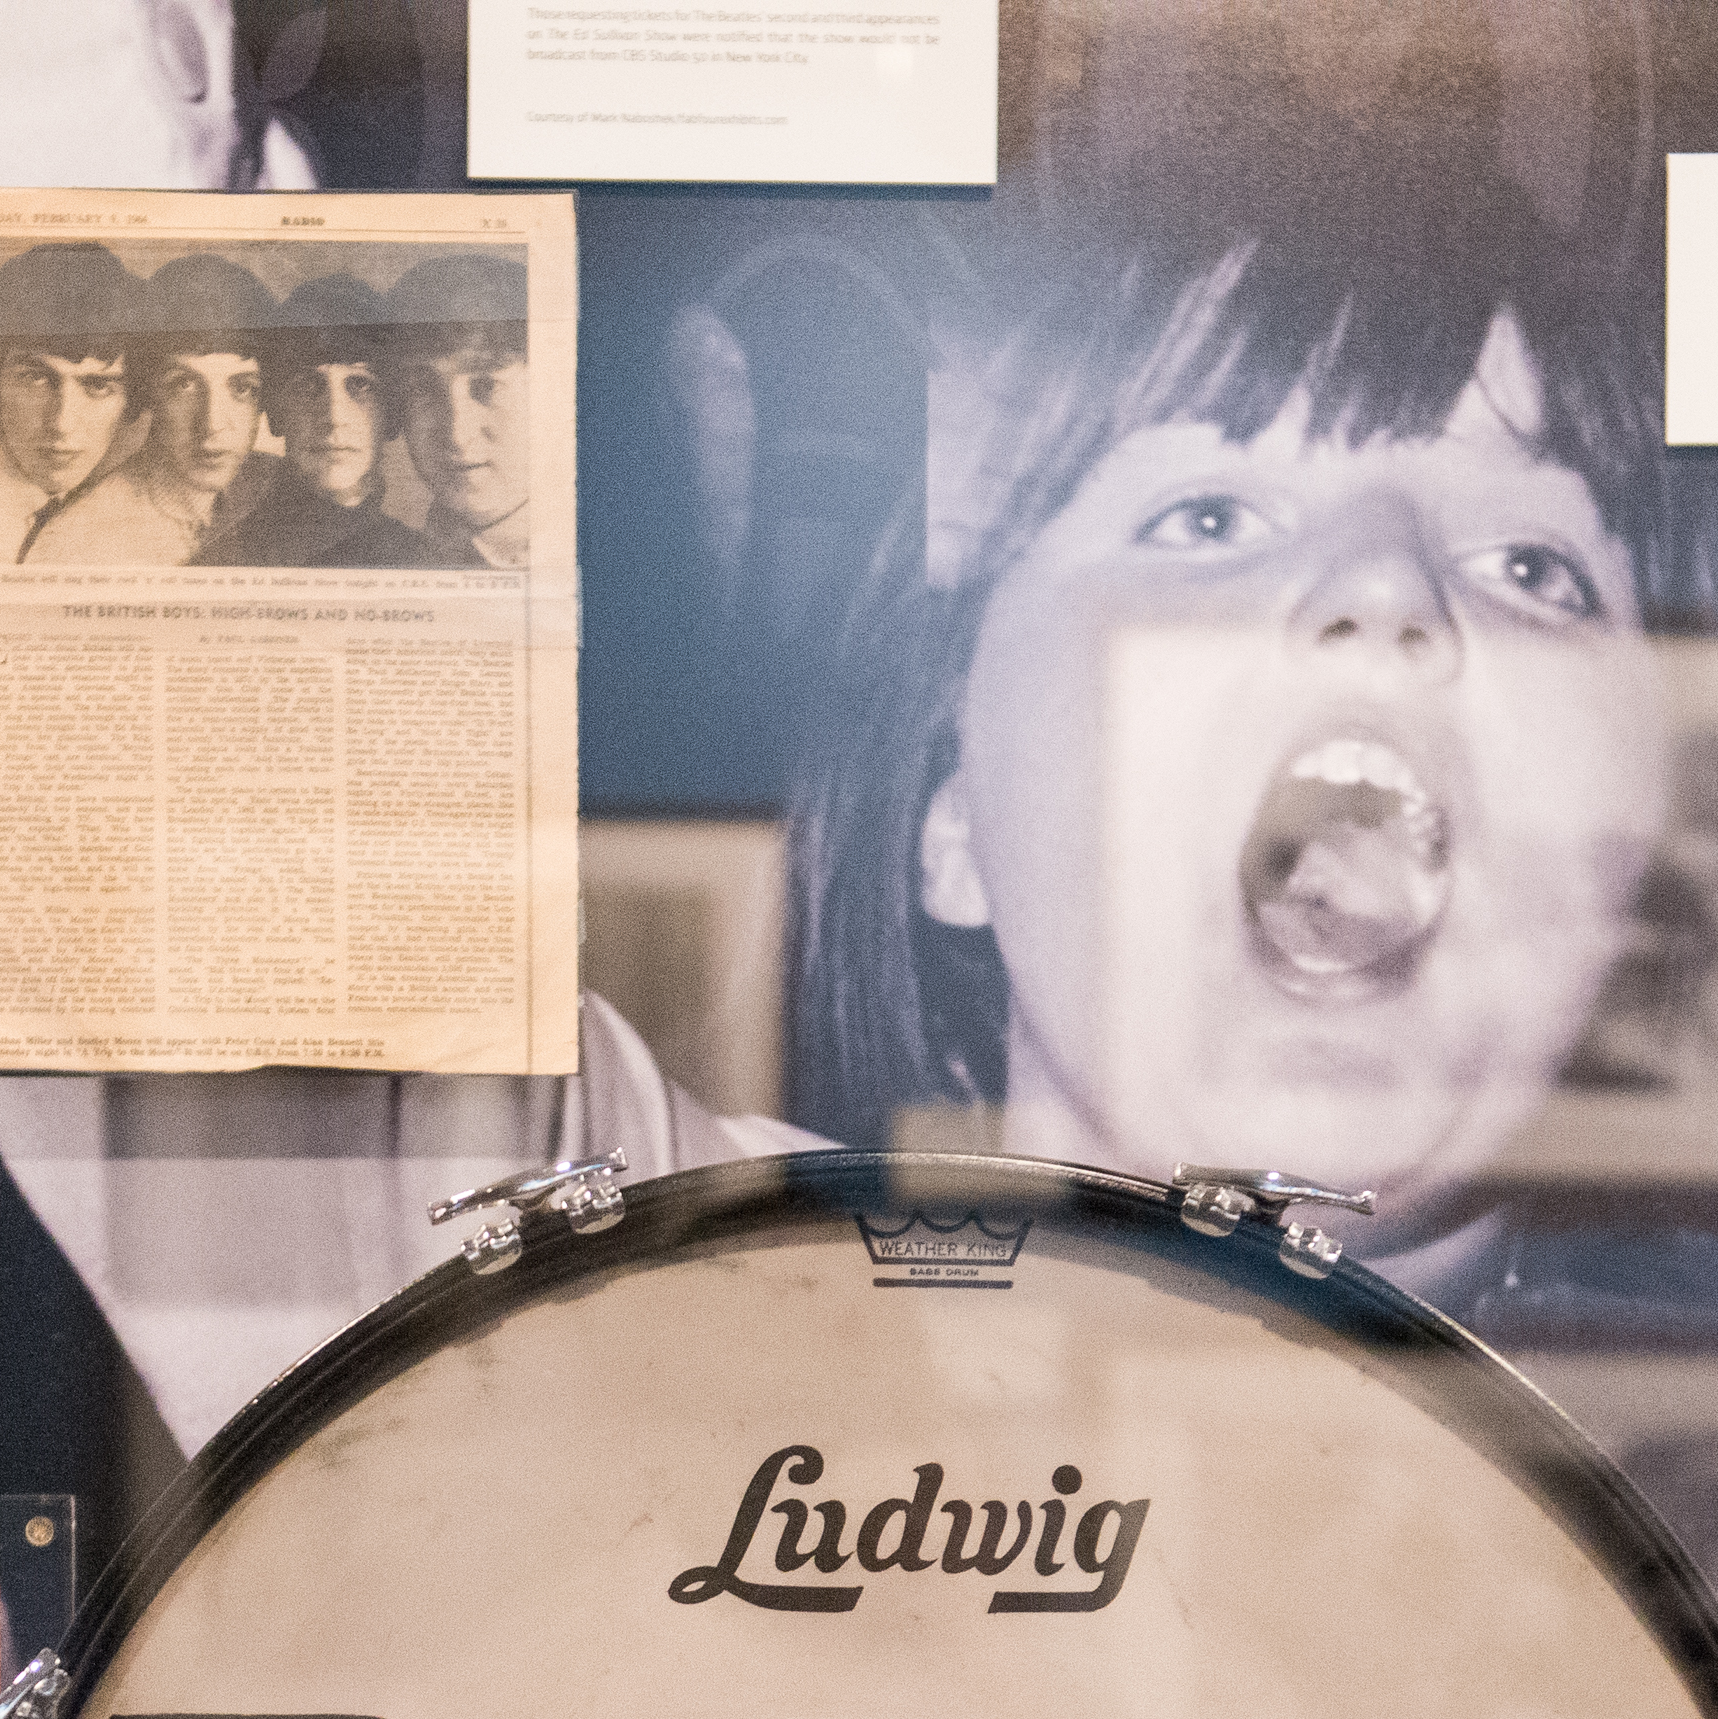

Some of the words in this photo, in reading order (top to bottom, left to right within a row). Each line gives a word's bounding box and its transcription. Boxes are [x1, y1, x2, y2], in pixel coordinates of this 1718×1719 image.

[63, 604, 92, 618] THE
[97, 605, 157, 619] BRITISH
[314, 609, 347, 621] AND
[879, 1240, 958, 1256] WEATHER
[966, 1241, 1007, 1257] KING
[909, 1267, 941, 1276] BASS
[945, 1267, 979, 1277] DRUM
[667, 1444, 1152, 1615] Ludwig
